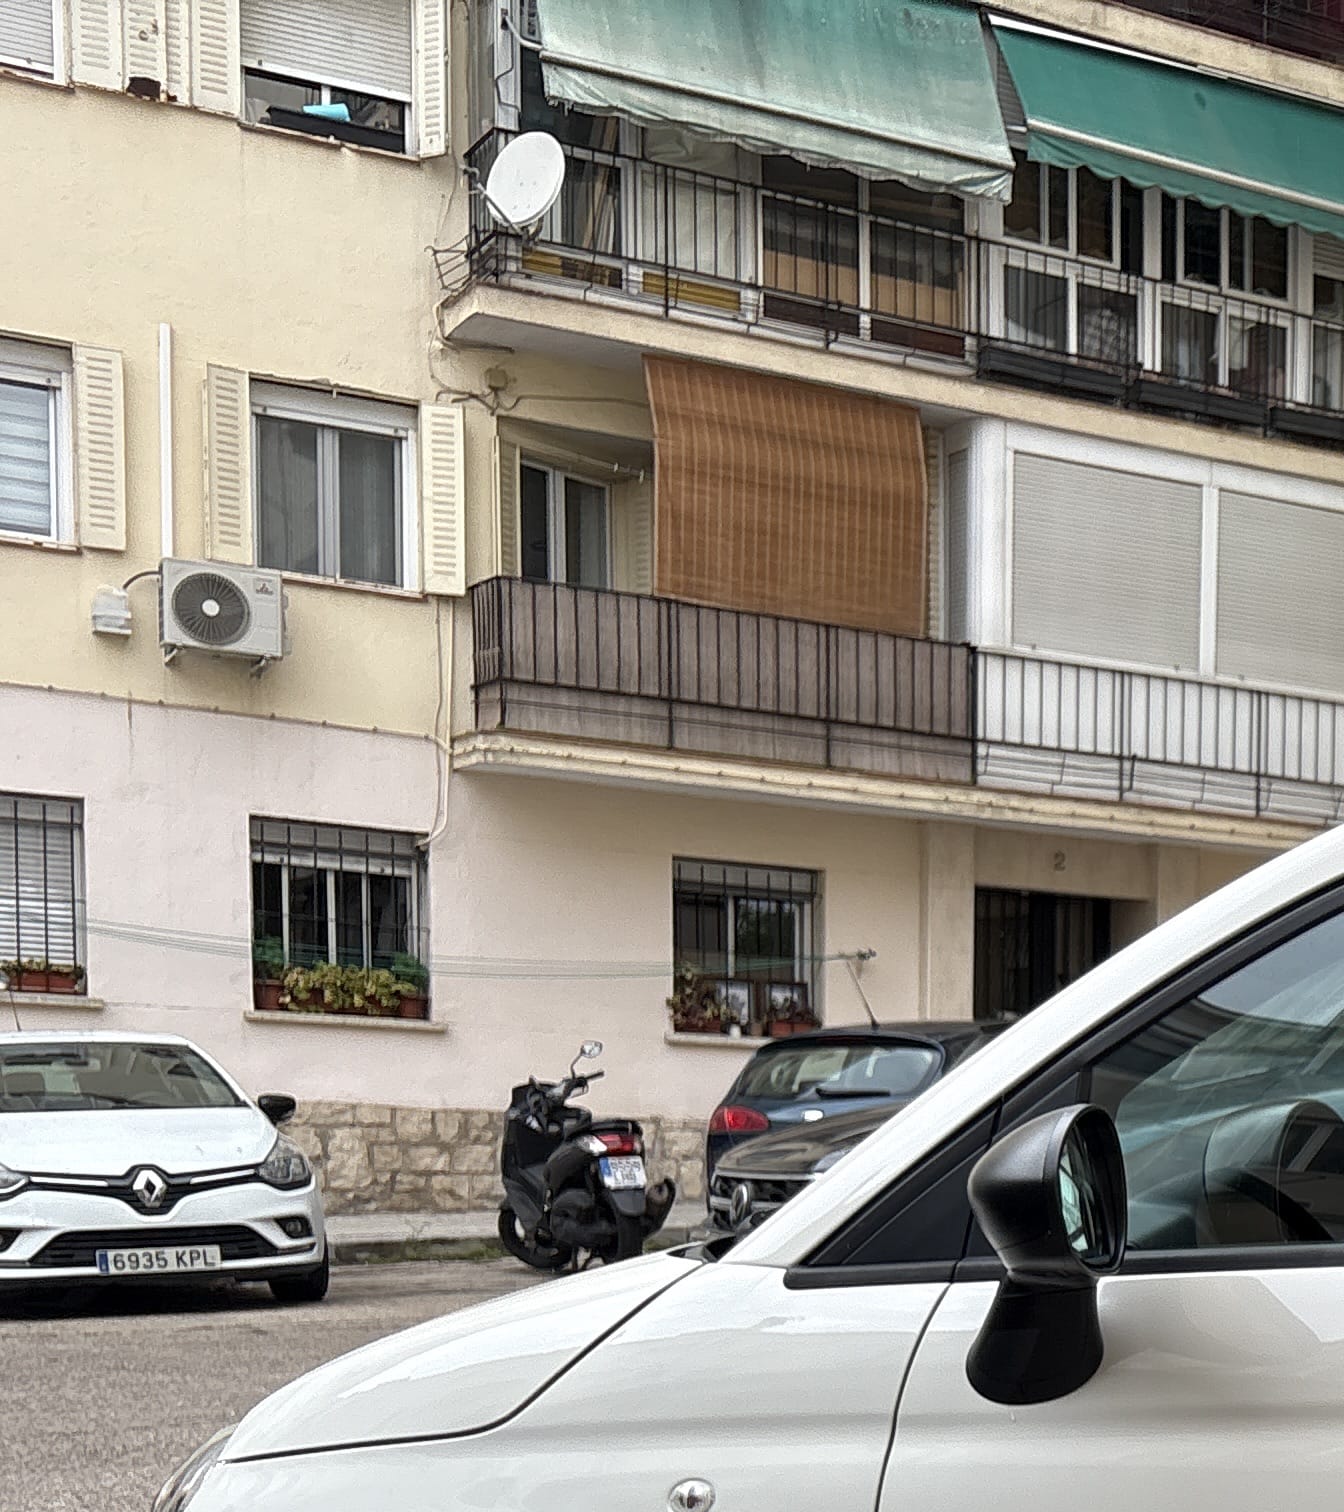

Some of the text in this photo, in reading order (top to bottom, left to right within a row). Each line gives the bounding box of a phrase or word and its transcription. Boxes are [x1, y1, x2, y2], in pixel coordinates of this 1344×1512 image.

[1053, 849, 1066, 871] 2
[113, 1248, 216, 1271] 6935 KPL
